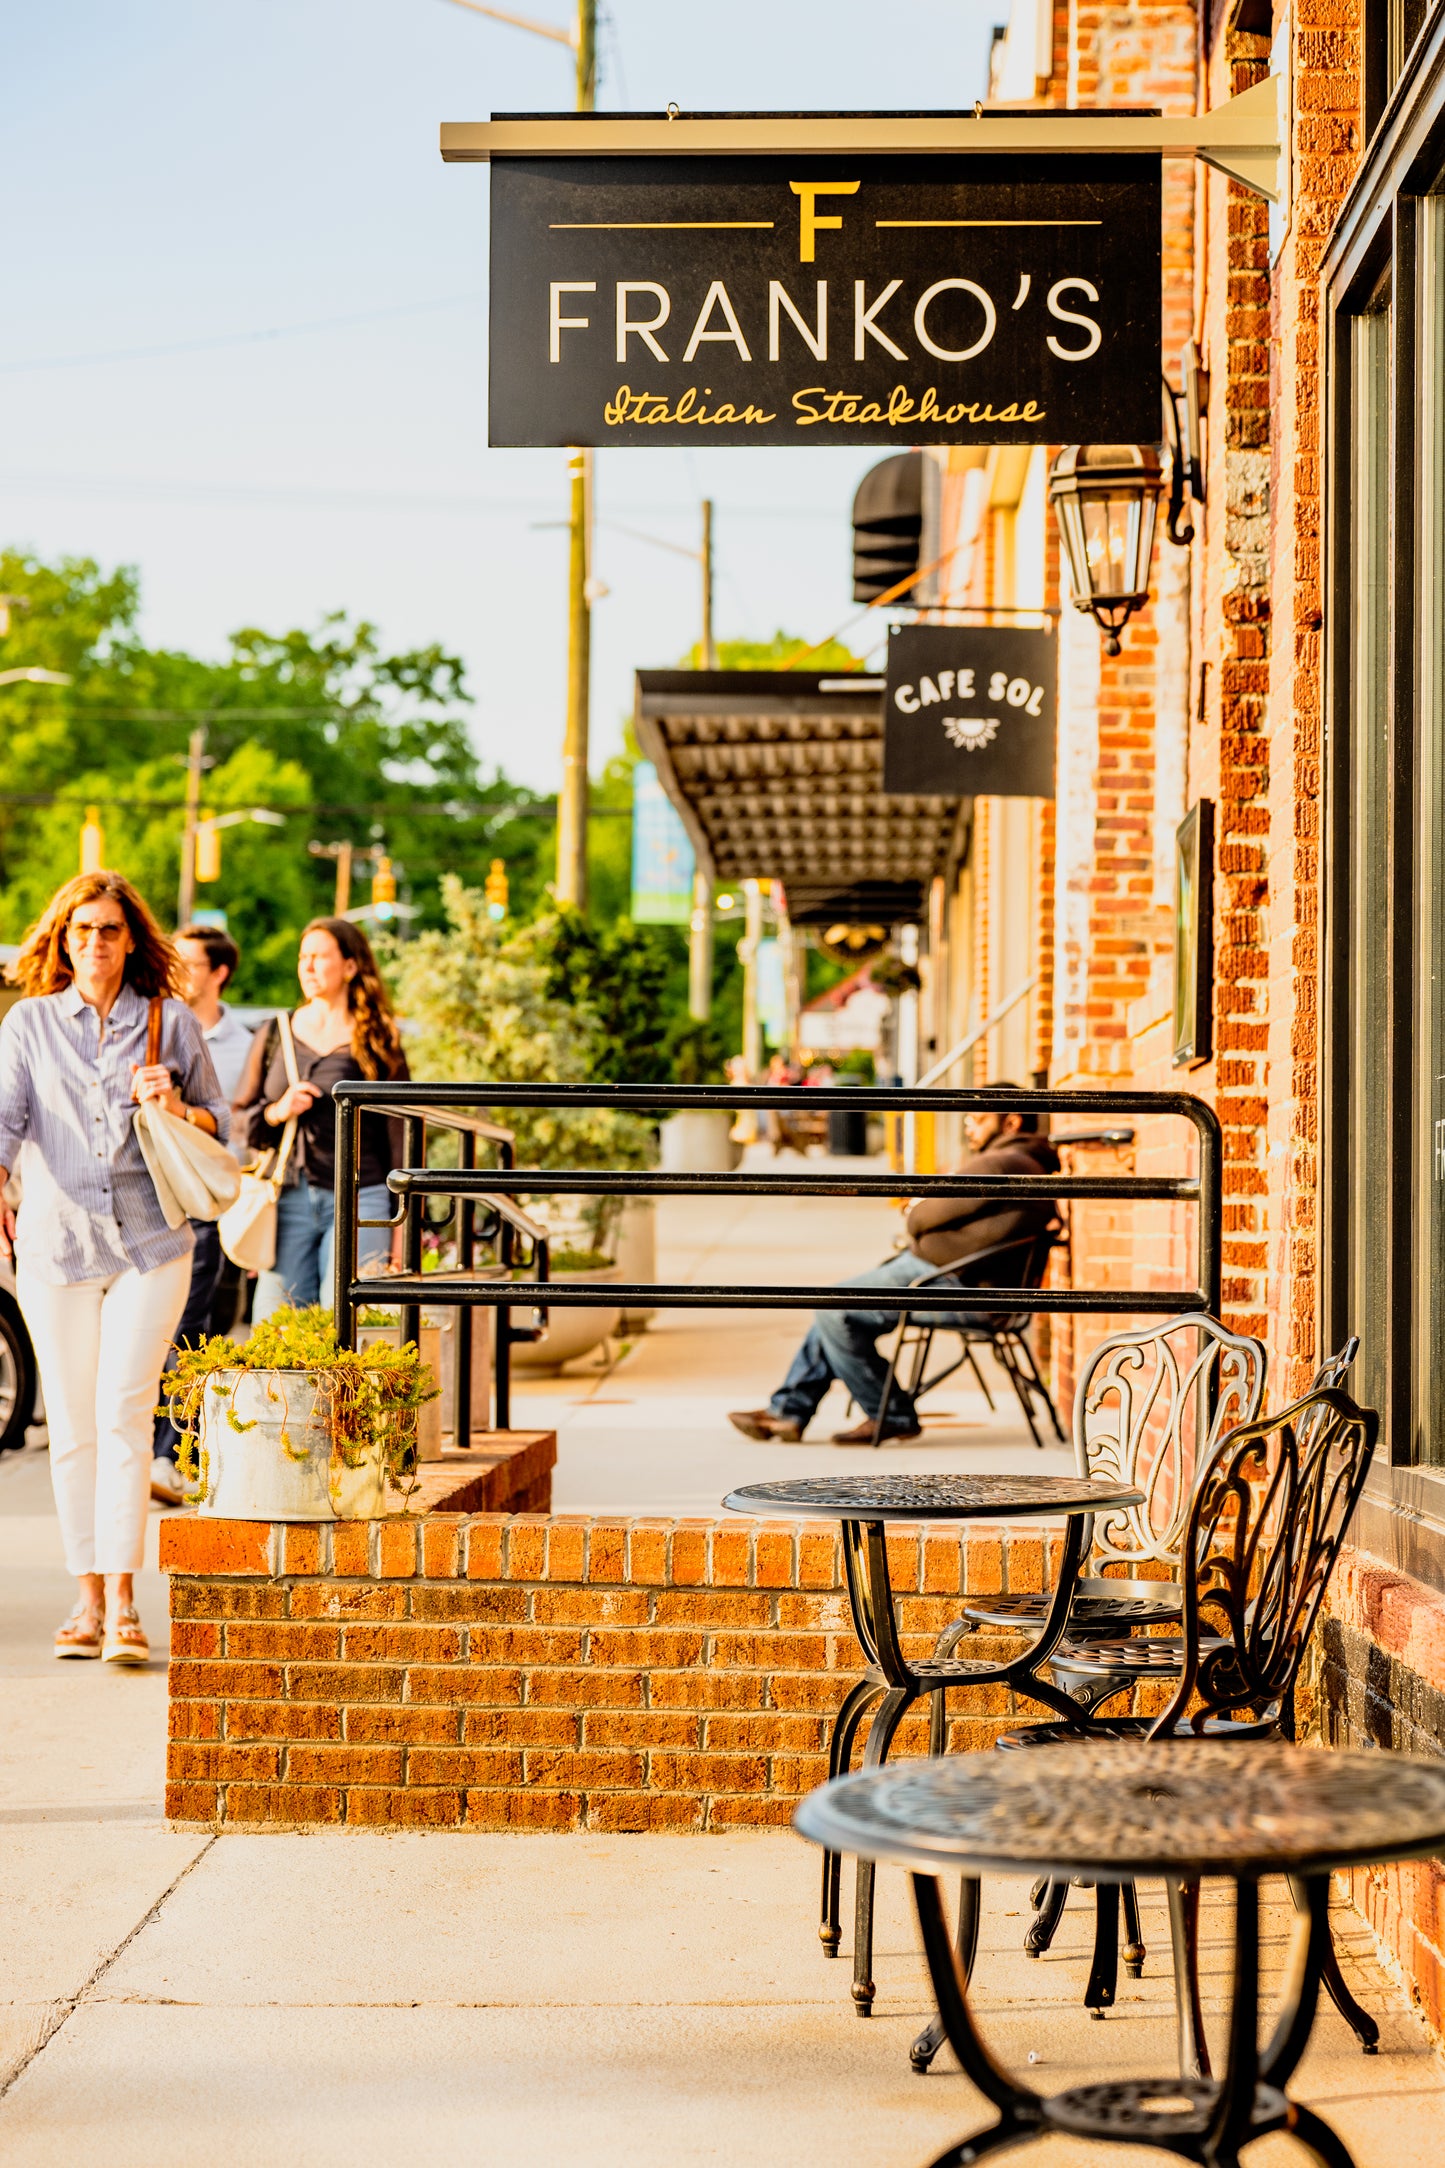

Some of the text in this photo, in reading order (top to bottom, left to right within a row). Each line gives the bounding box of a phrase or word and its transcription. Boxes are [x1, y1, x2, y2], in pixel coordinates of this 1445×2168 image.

[789, 181, 860, 262] F
[549, 274, 1102, 363] FRANKO'S
[604, 385, 1046, 425] Italian Steakhouse
[894, 668, 1045, 717] CAFE SOL
